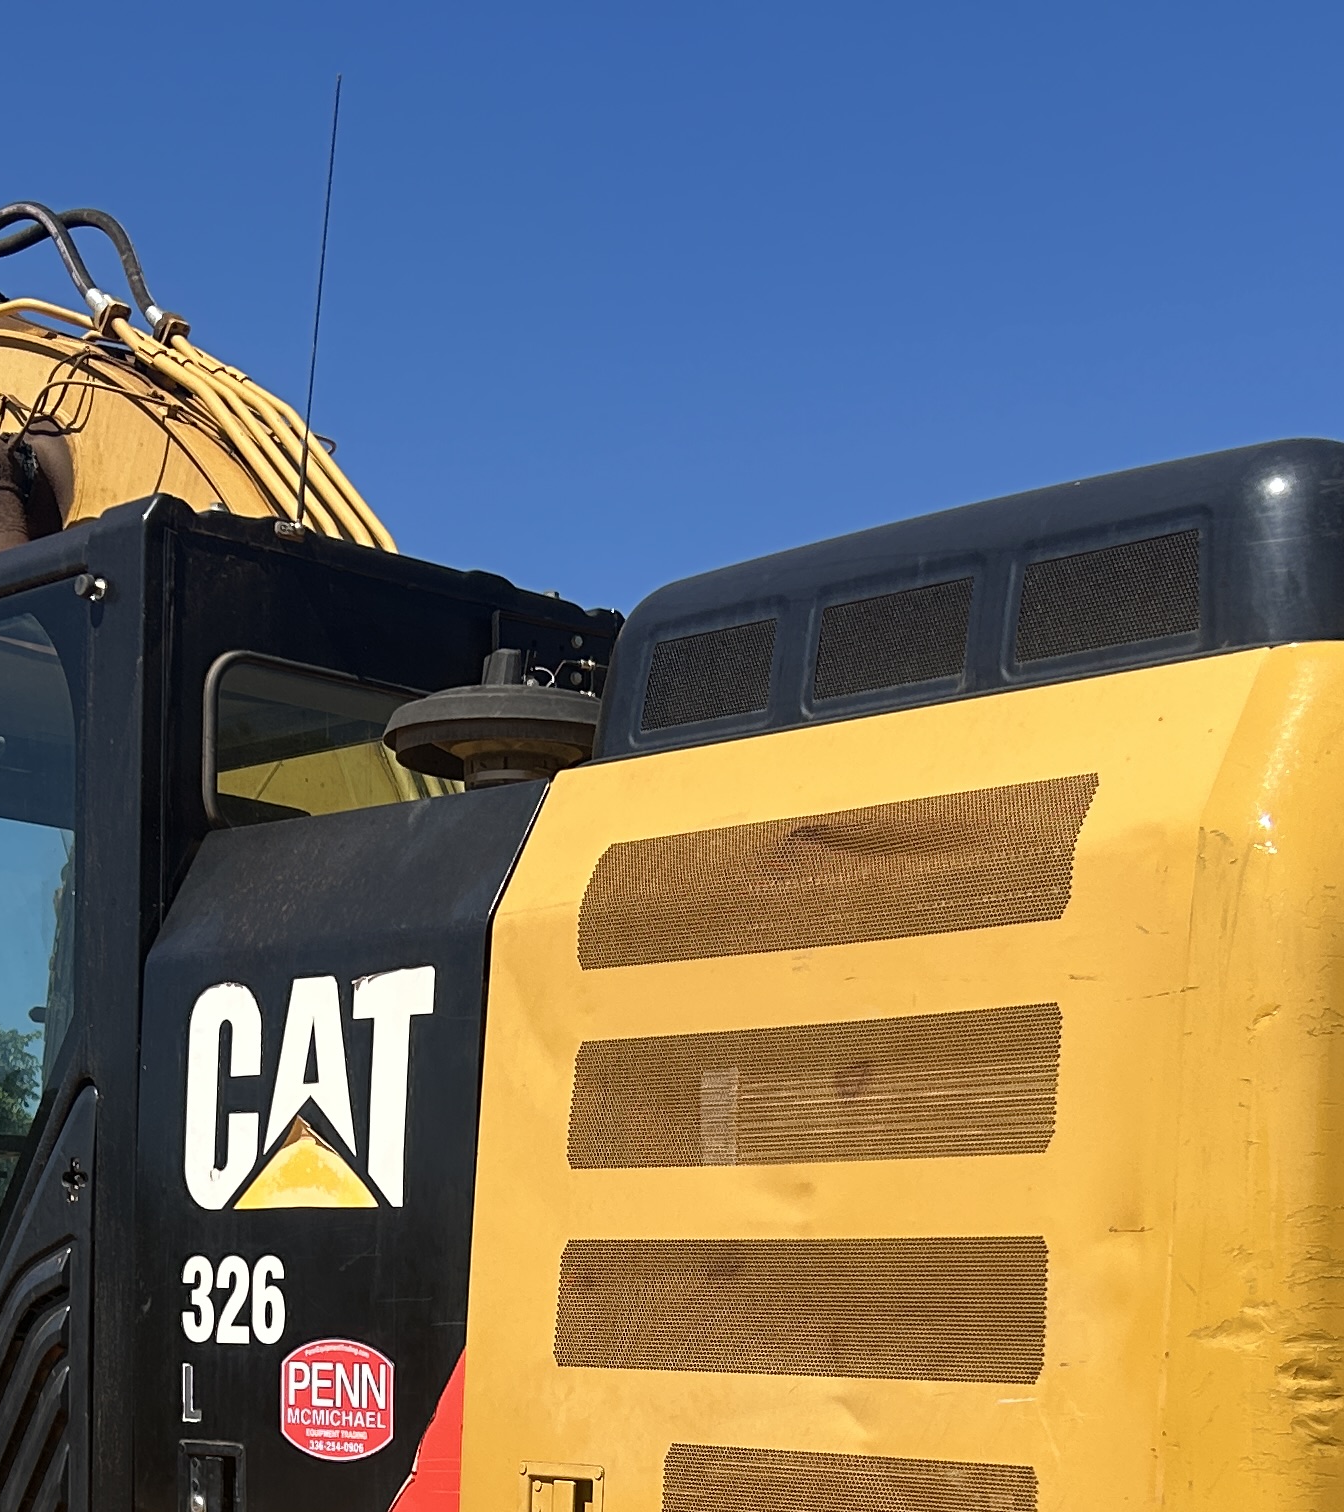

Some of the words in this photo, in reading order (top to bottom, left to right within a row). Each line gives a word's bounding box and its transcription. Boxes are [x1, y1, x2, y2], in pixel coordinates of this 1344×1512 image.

[184, 966, 435, 1210] CAT
[182, 1255, 286, 1344] 326
[182, 1363, 202, 1422] L
[288, 1361, 387, 1410] PENN
[287, 1407, 387, 1429] MCMICHAEL
